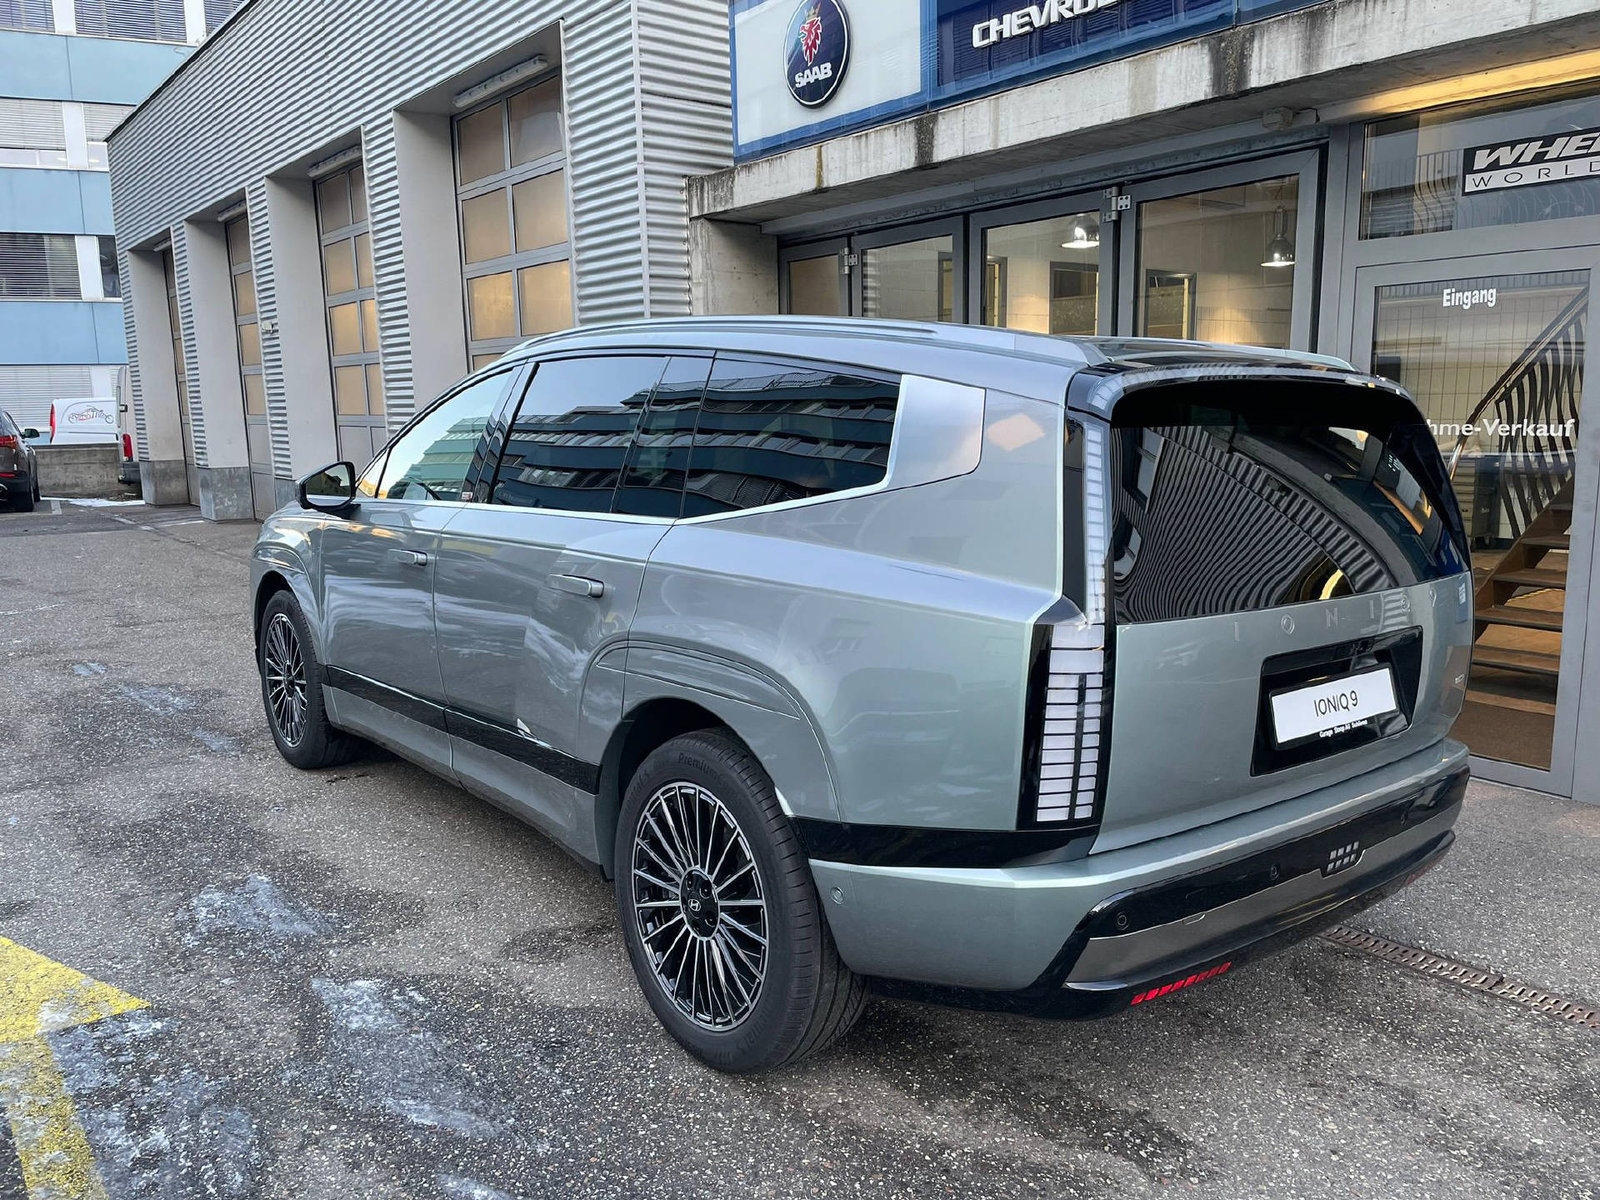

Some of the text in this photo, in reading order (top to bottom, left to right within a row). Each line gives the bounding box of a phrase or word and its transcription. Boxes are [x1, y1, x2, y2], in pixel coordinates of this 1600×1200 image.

[972, 0, 1119, 48] CHEVRO
[795, 62, 832, 89] SAAB
[1442, 287, 1497, 310] Eingang
[1313, 690, 1358, 717] IONIQ 9
